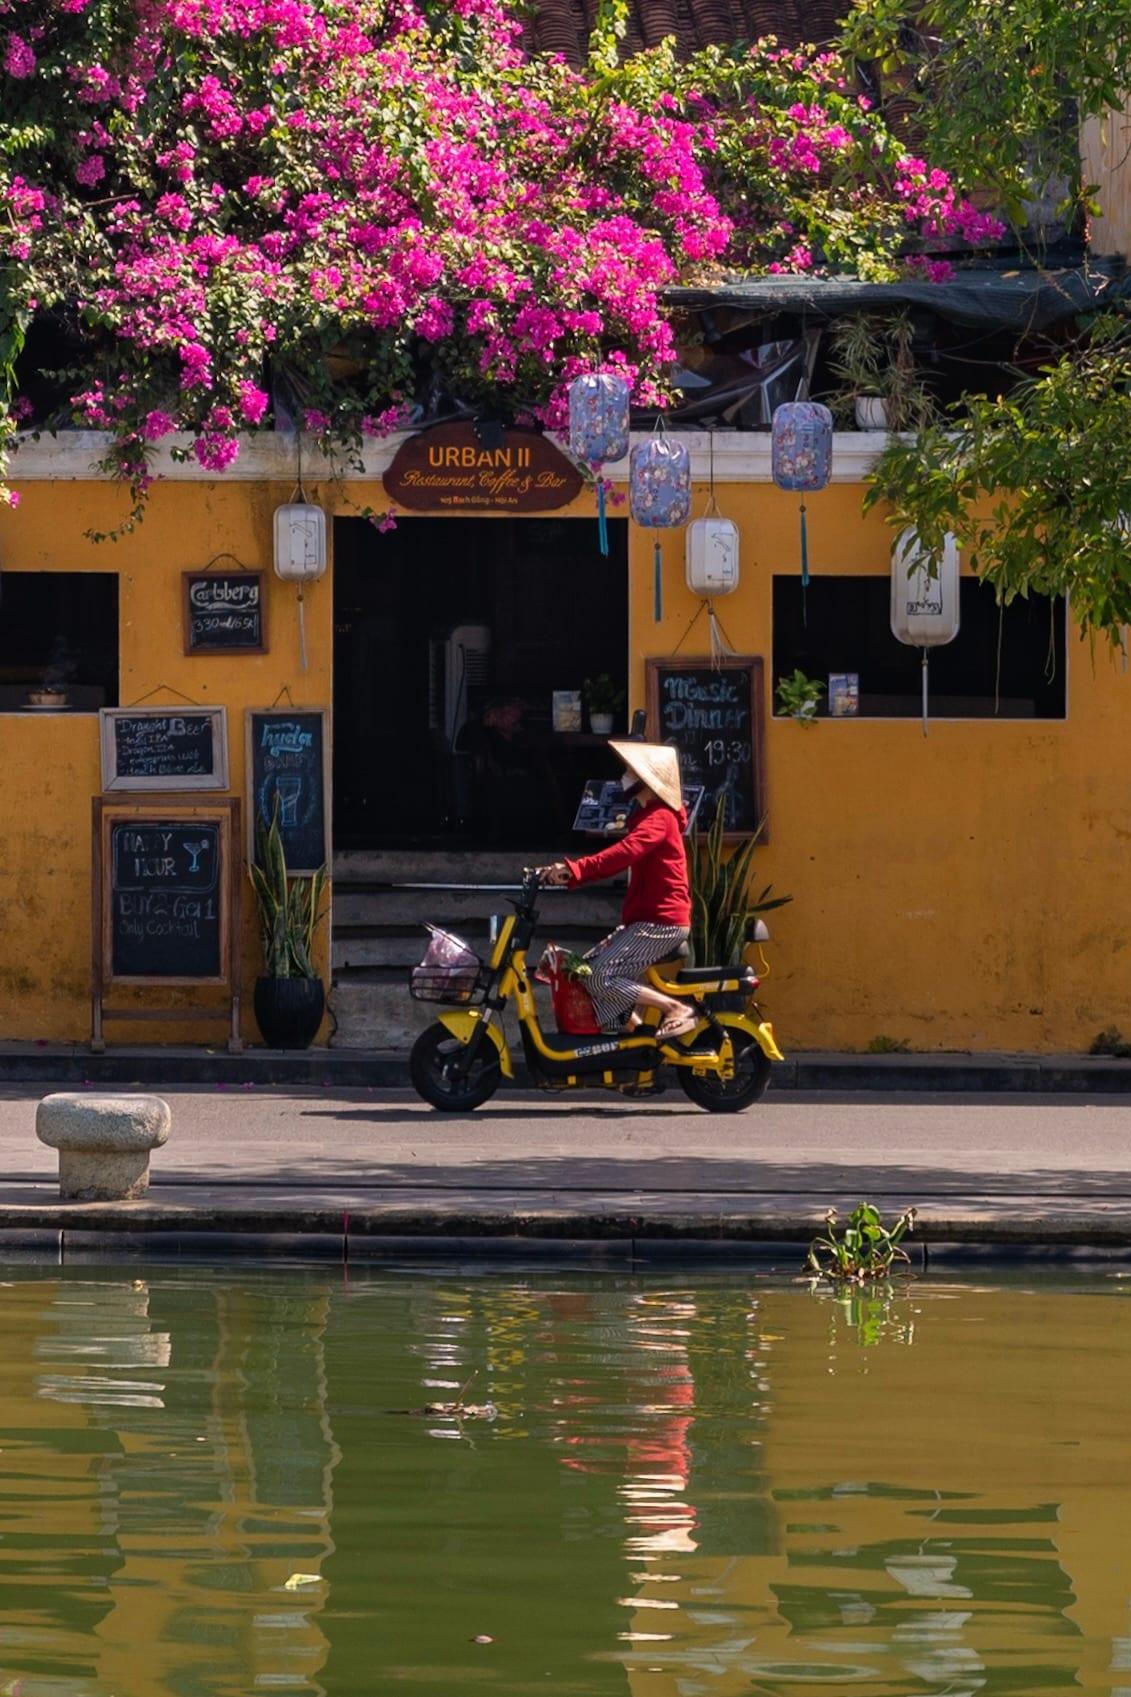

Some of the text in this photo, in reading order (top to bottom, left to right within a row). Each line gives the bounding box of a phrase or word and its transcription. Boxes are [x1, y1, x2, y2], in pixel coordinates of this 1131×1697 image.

[428, 447, 512, 467] URBAN
[400, 470, 476, 489] Restaurant,
[478, 468, 520, 494] Coffee
[535, 471, 568, 489] Bar
[190, 581, 260, 608] Carlsberg
[704, 739, 751, 767] 19:30
[123, 832, 173, 853] HAY
